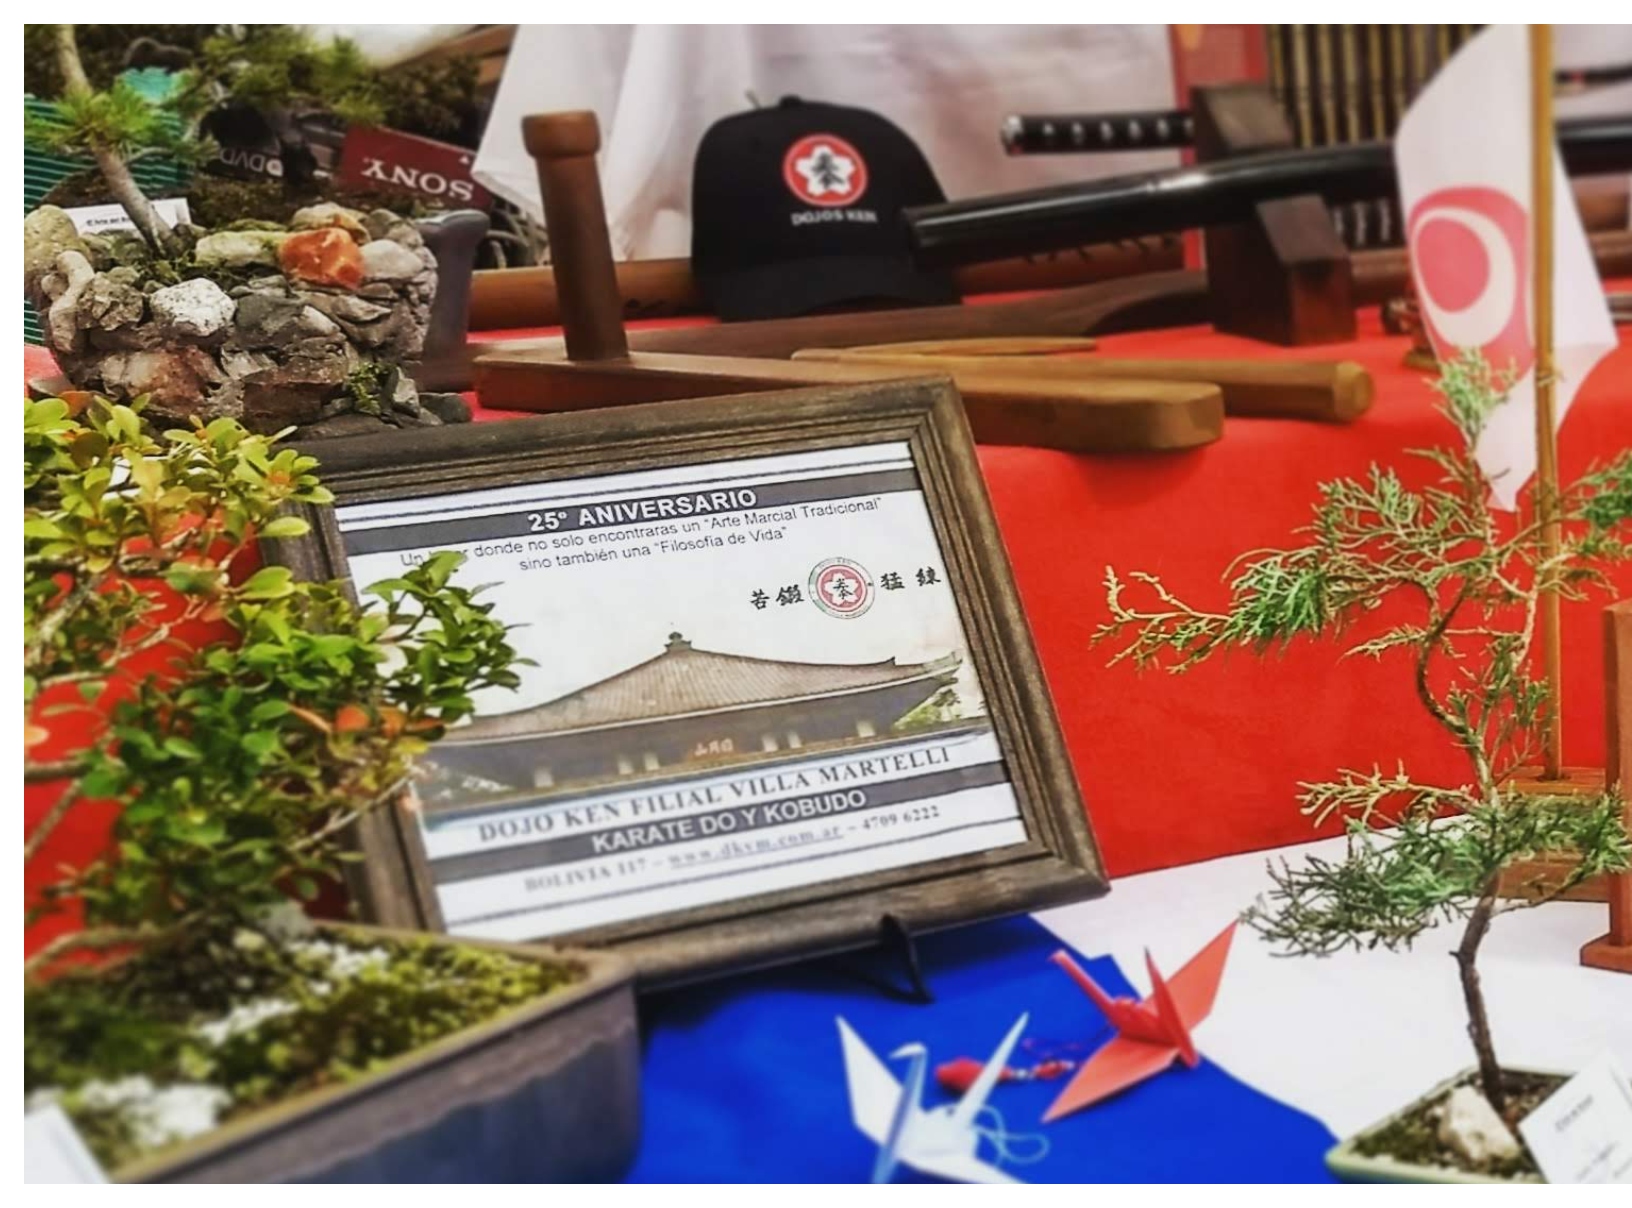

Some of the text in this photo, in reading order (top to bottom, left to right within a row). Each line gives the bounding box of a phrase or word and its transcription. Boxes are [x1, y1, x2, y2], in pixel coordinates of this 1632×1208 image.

[220, 147, 266, 173] DVD
[360, 159, 475, 201] SONY
[790, 209, 878, 226] DOJOS KEN
[578, 488, 757, 527] ANIVERSARIO
[473, 541, 523, 558] donde
[528, 539, 549, 551] no
[552, 532, 584, 548] solo
[589, 523, 678, 545] encontraras
[681, 519, 701, 533] un
[744, 507, 798, 526] Marcial
[519, 556, 553, 571] sino
[556, 545, 618, 567] también
[623, 544, 652, 559] una
[728, 529, 747, 546] de
[477, 746, 951, 843] DOJO KEN FILIAL VILLA MARTELLI
[591, 789, 867, 854] KARATE DO Y KOBUDO
[524, 865, 613, 894] BOLIVIA
[616, 857, 648, 877] 117
[861, 814, 899, 832] 4709
[902, 804, 942, 826] 6222
